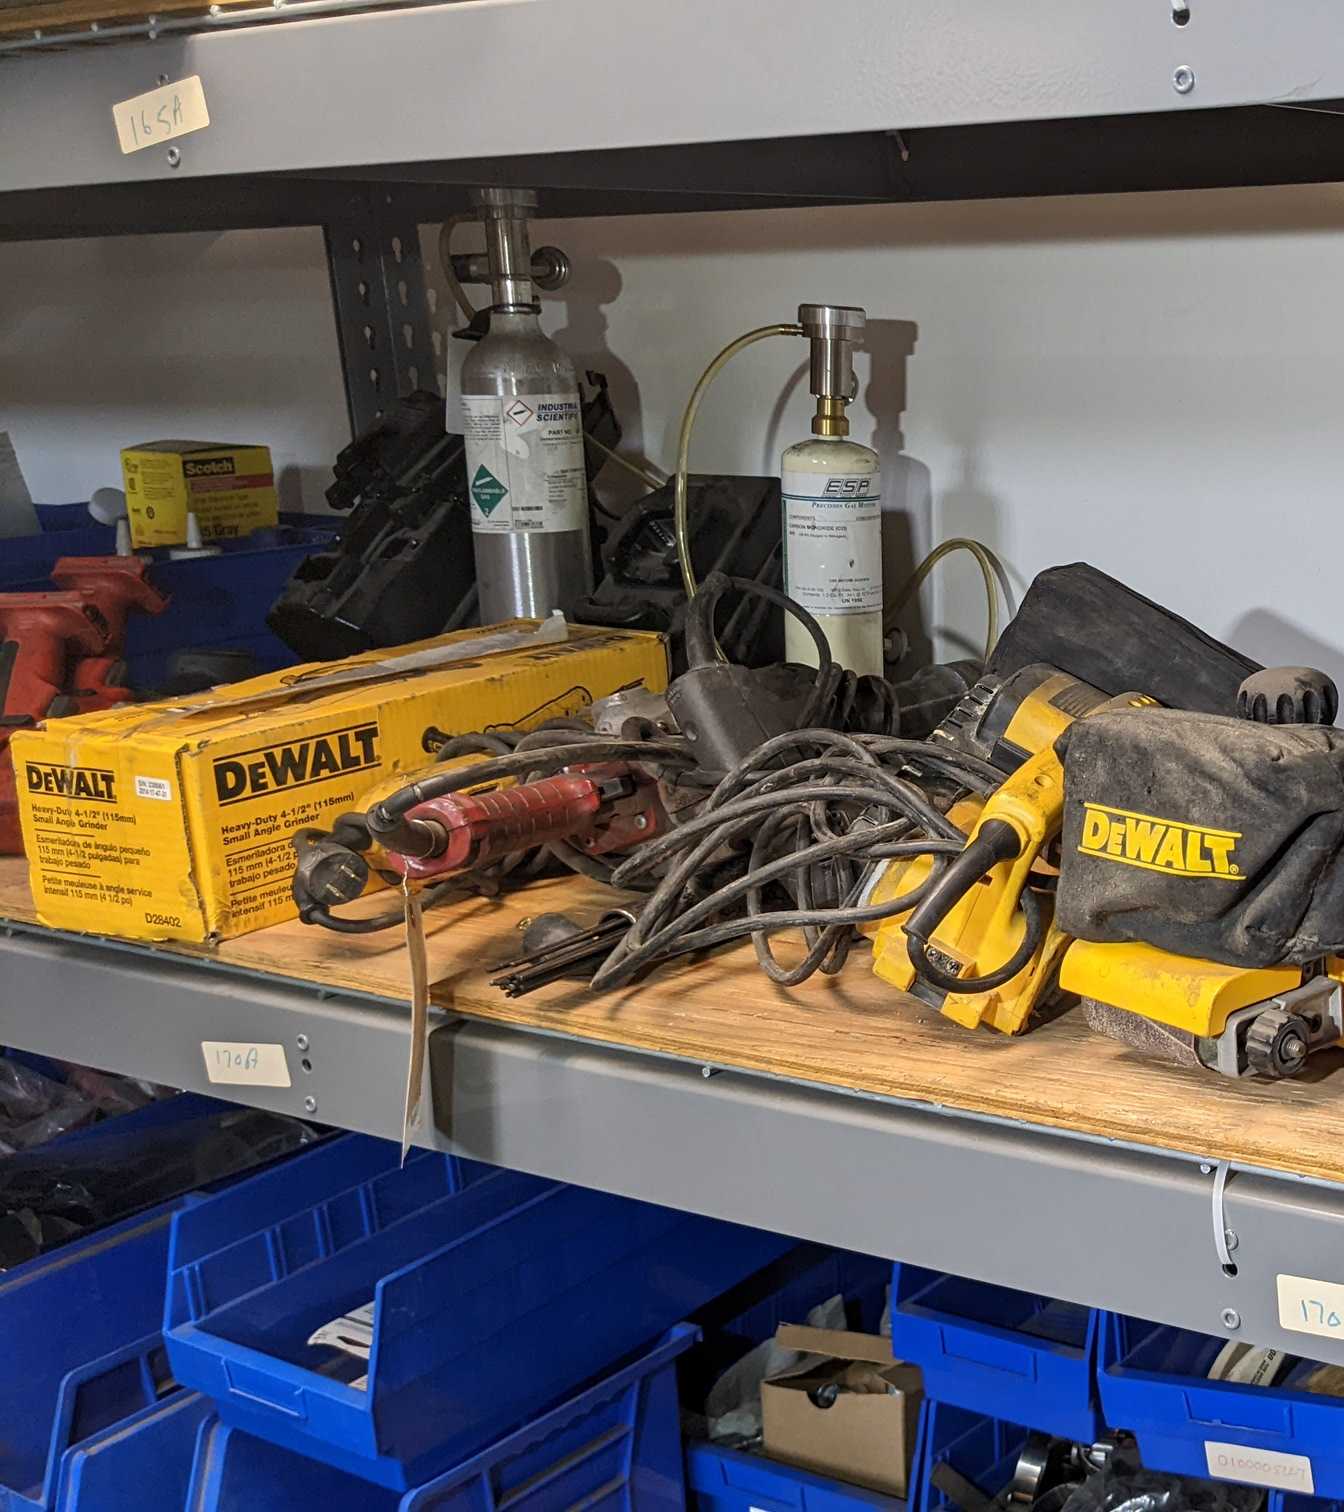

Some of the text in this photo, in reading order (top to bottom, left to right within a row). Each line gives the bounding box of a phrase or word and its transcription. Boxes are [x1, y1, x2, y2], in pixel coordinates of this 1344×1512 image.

[185, 458, 234, 475] Scotch
[824, 478, 872, 494] ESP
[213, 727, 382, 802] DEWALT
[31, 803, 72, 818] Heavy-Duty
[102, 811, 137, 826] (115mm)
[33, 814, 108, 831] Small Angle Grinder
[221, 813, 278, 835] Heavy-Duty
[313, 792, 356, 812] (115mm)
[223, 813, 320, 846] Small Angle Grinder
[1082, 808, 1236, 874] DEWALT
[37, 845, 50, 855] 115
[52, 847, 65, 856] mm
[124, 857, 140, 866] para
[82, 839, 92, 849] de
[226, 844, 286, 868] Esmeriladora
[65, 859, 91, 870] pesado
[228, 868, 245, 878] 115
[246, 860, 263, 872] mm
[265, 850, 292, 868] (4-1/2
[229, 862, 296, 889] trabajo pesado
[42, 874, 62, 886] Petite
[105, 883, 125, 895] angle
[127, 887, 153, 898] service
[71, 888, 83, 898] 115
[84, 891, 98, 901] mm
[230, 885, 294, 909] Petite meuleu
[231, 903, 266, 919] intensif
[268, 895, 284, 908] 115
[144, 911, 183, 929] D28402
